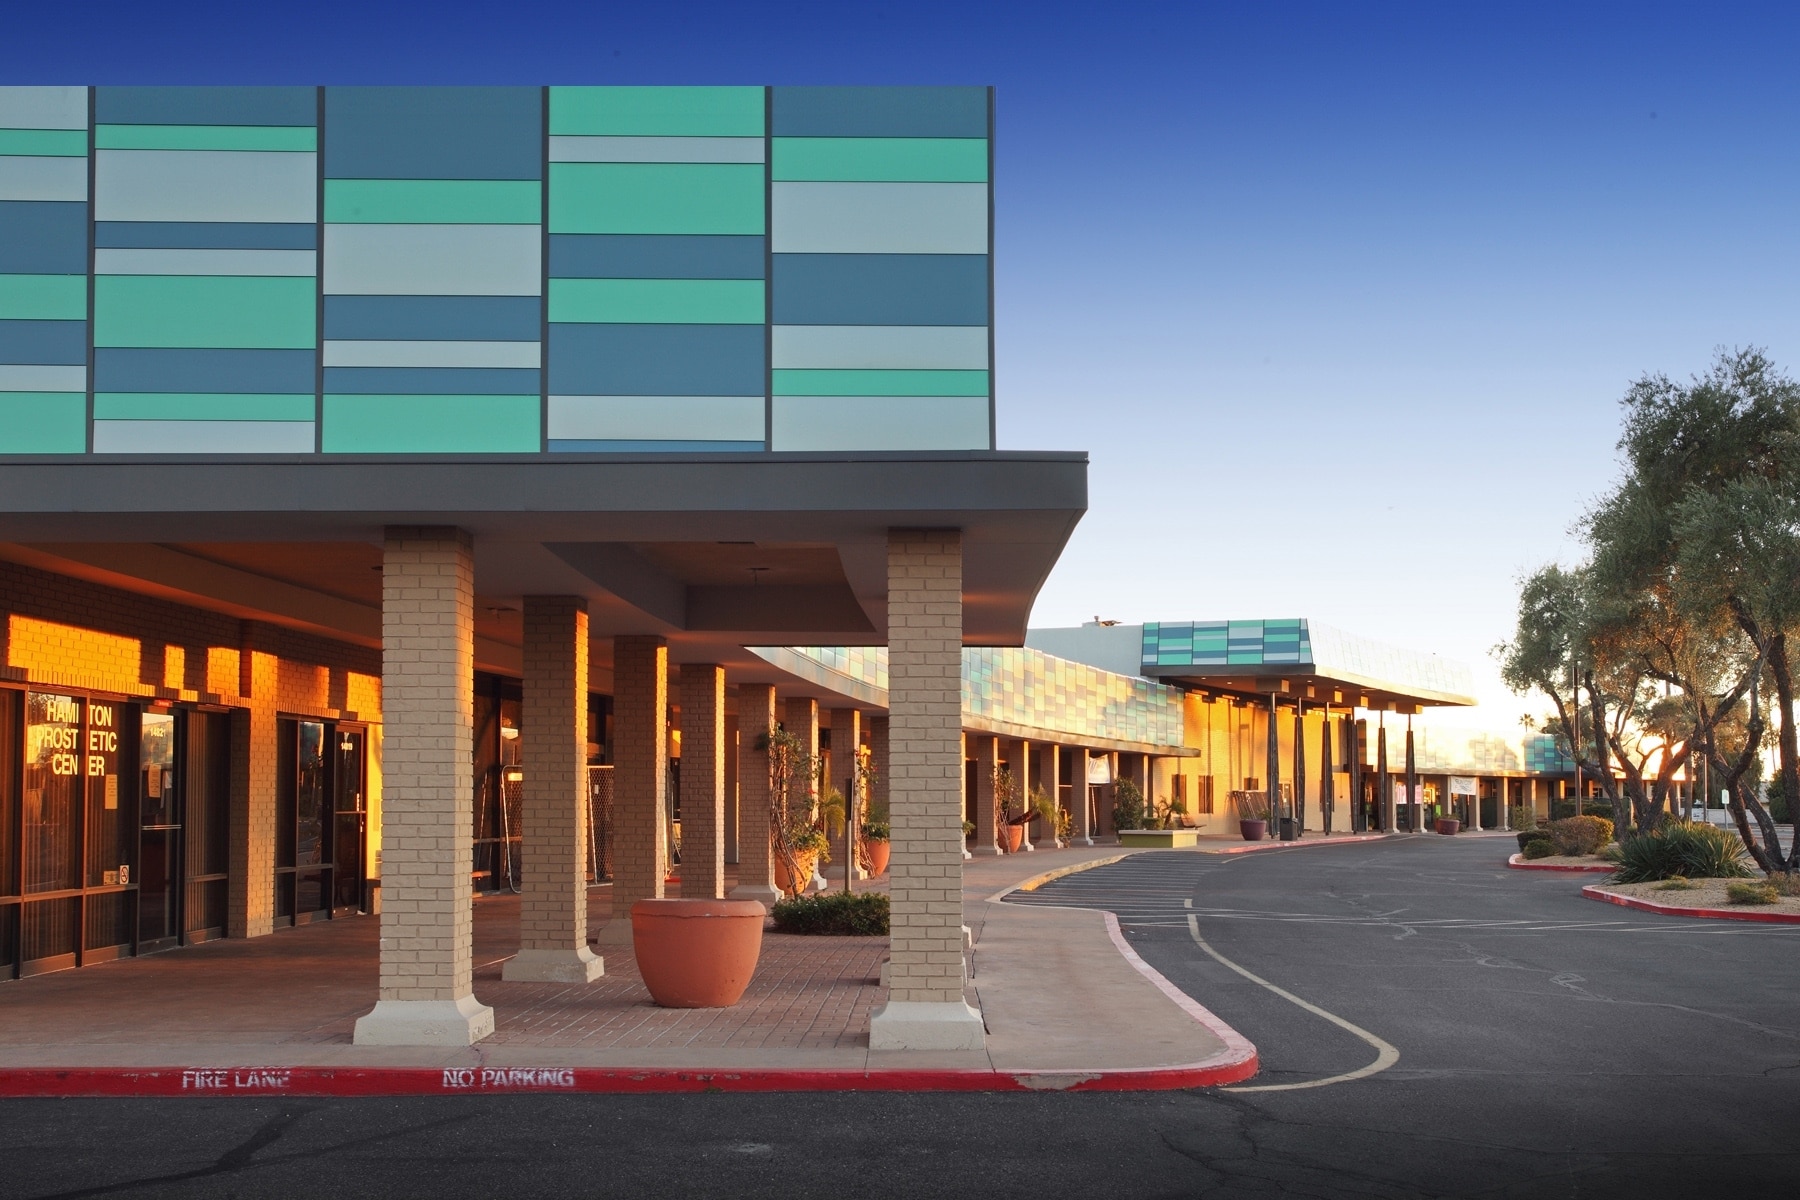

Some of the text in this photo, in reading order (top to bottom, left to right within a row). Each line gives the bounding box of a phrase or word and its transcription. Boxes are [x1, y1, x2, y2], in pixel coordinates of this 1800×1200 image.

[46, 700, 112, 727] HAMITON
[36, 726, 117, 752] PROSTETIC
[52, 753, 105, 776] CENER
[182, 1070, 290, 1089] FIRE LANE
[442, 1069, 575, 1088] NO PARKING
